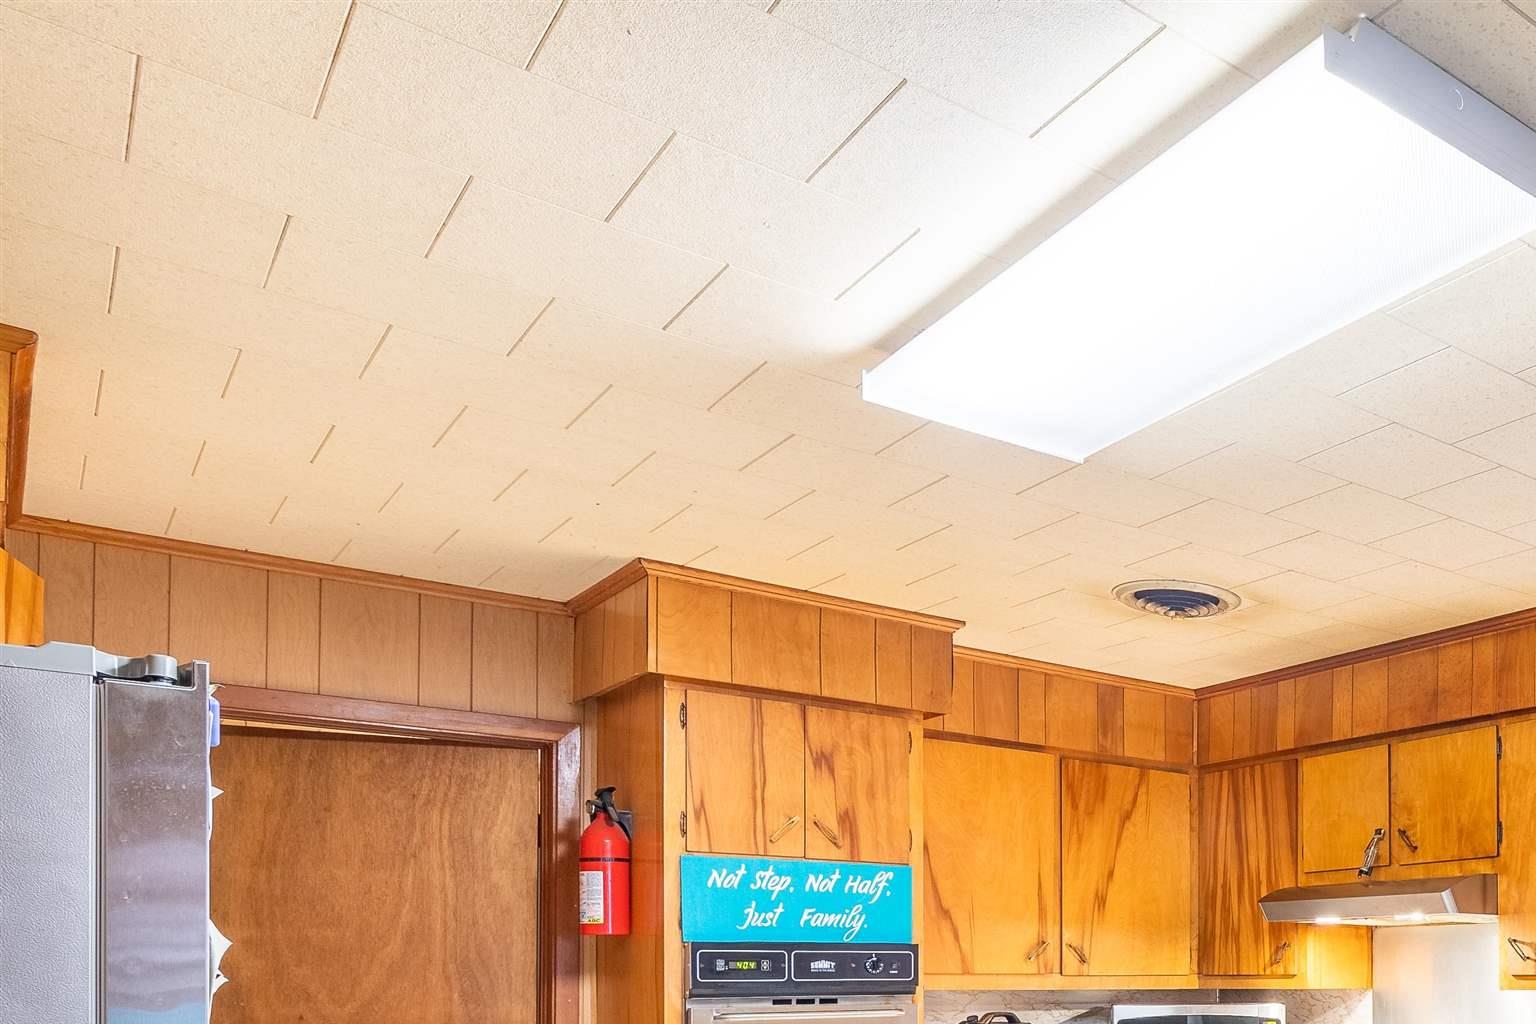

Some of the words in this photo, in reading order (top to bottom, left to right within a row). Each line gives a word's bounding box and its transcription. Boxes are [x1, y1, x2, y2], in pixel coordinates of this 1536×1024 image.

[707, 863, 747, 889] Not
[750, 865, 795, 901] Step.
[804, 869, 841, 893] Not
[844, 871, 894, 905] Half.
[736, 901, 784, 930] Just
[799, 904, 868, 942] Family.
